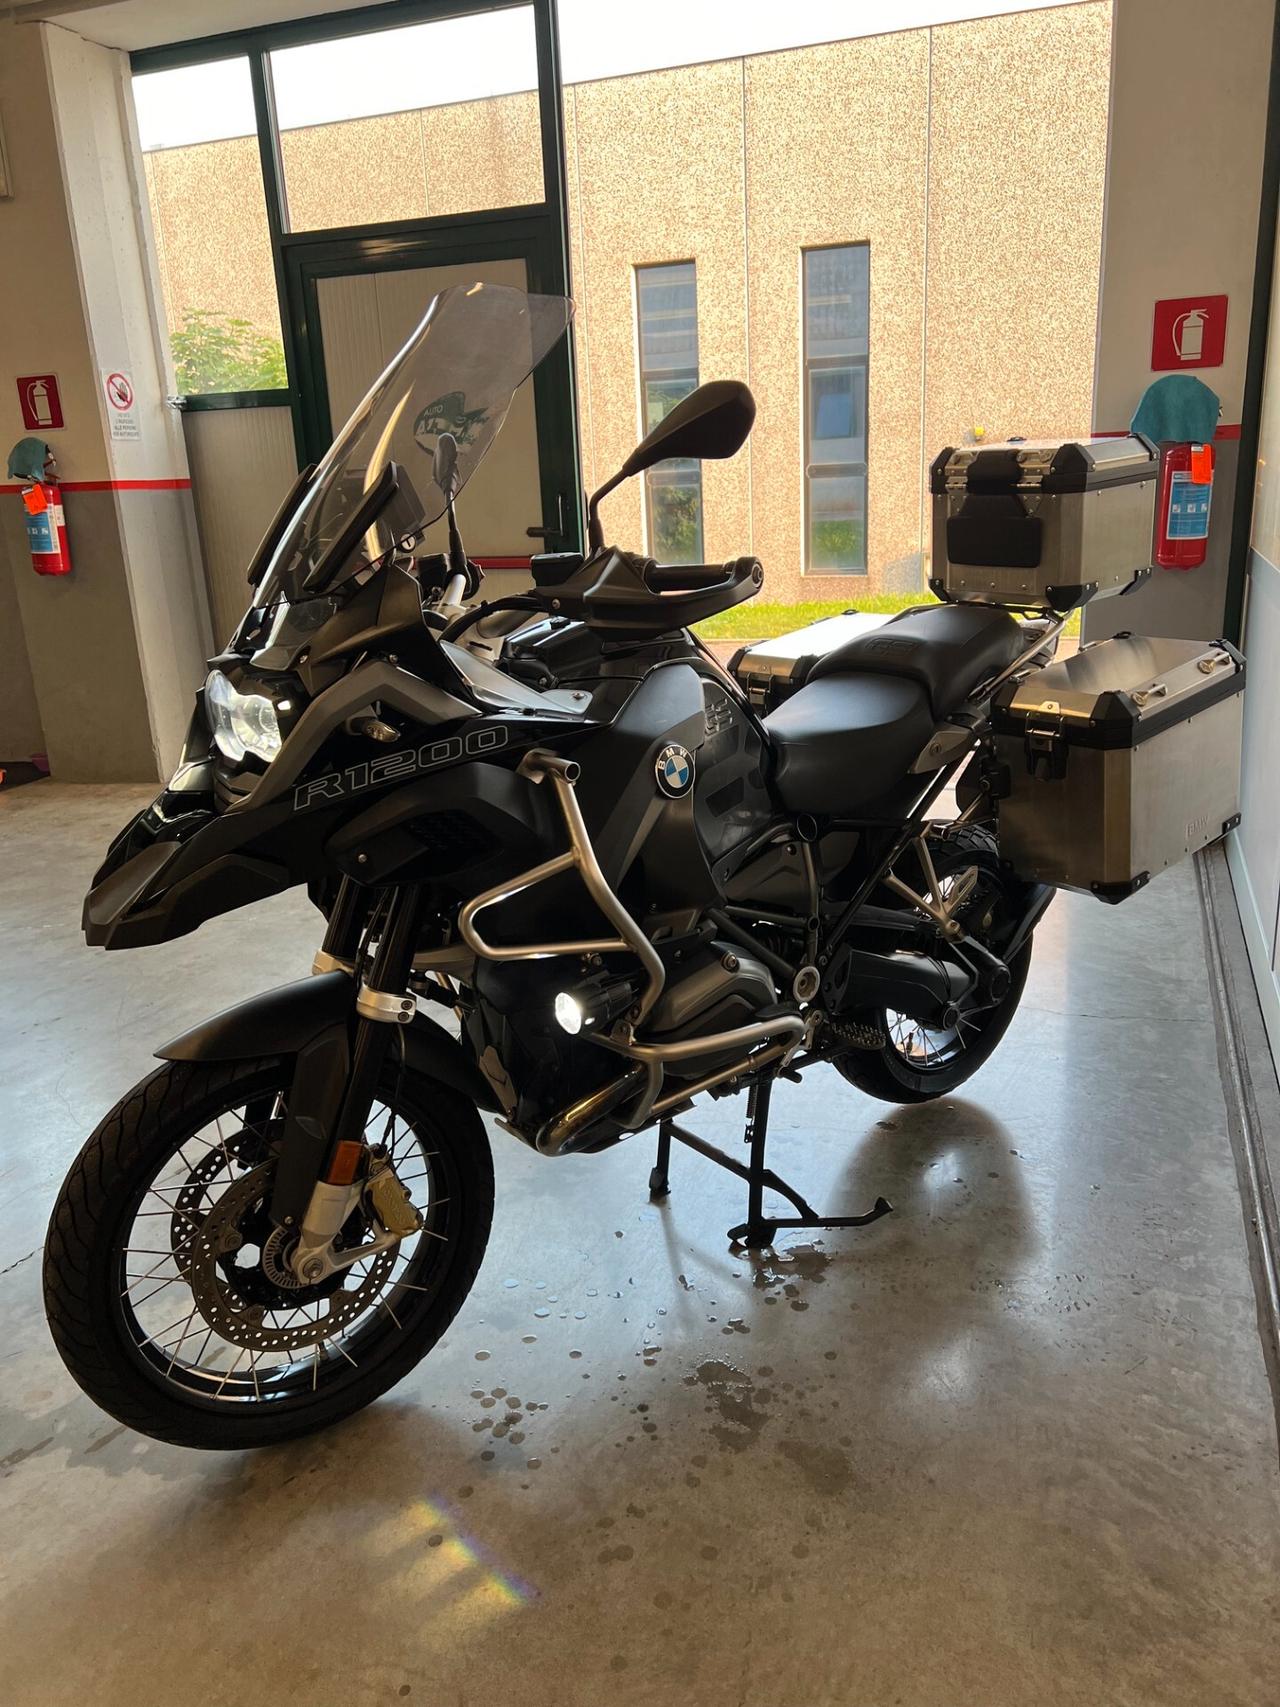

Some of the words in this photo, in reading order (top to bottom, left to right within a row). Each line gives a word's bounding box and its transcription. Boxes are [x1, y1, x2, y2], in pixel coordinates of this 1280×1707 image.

[424, 404, 443, 417] AUTO
[294, 725, 508, 811] R1200
[658, 747, 688, 770] BMW
[1187, 815, 1209, 836] BMW
